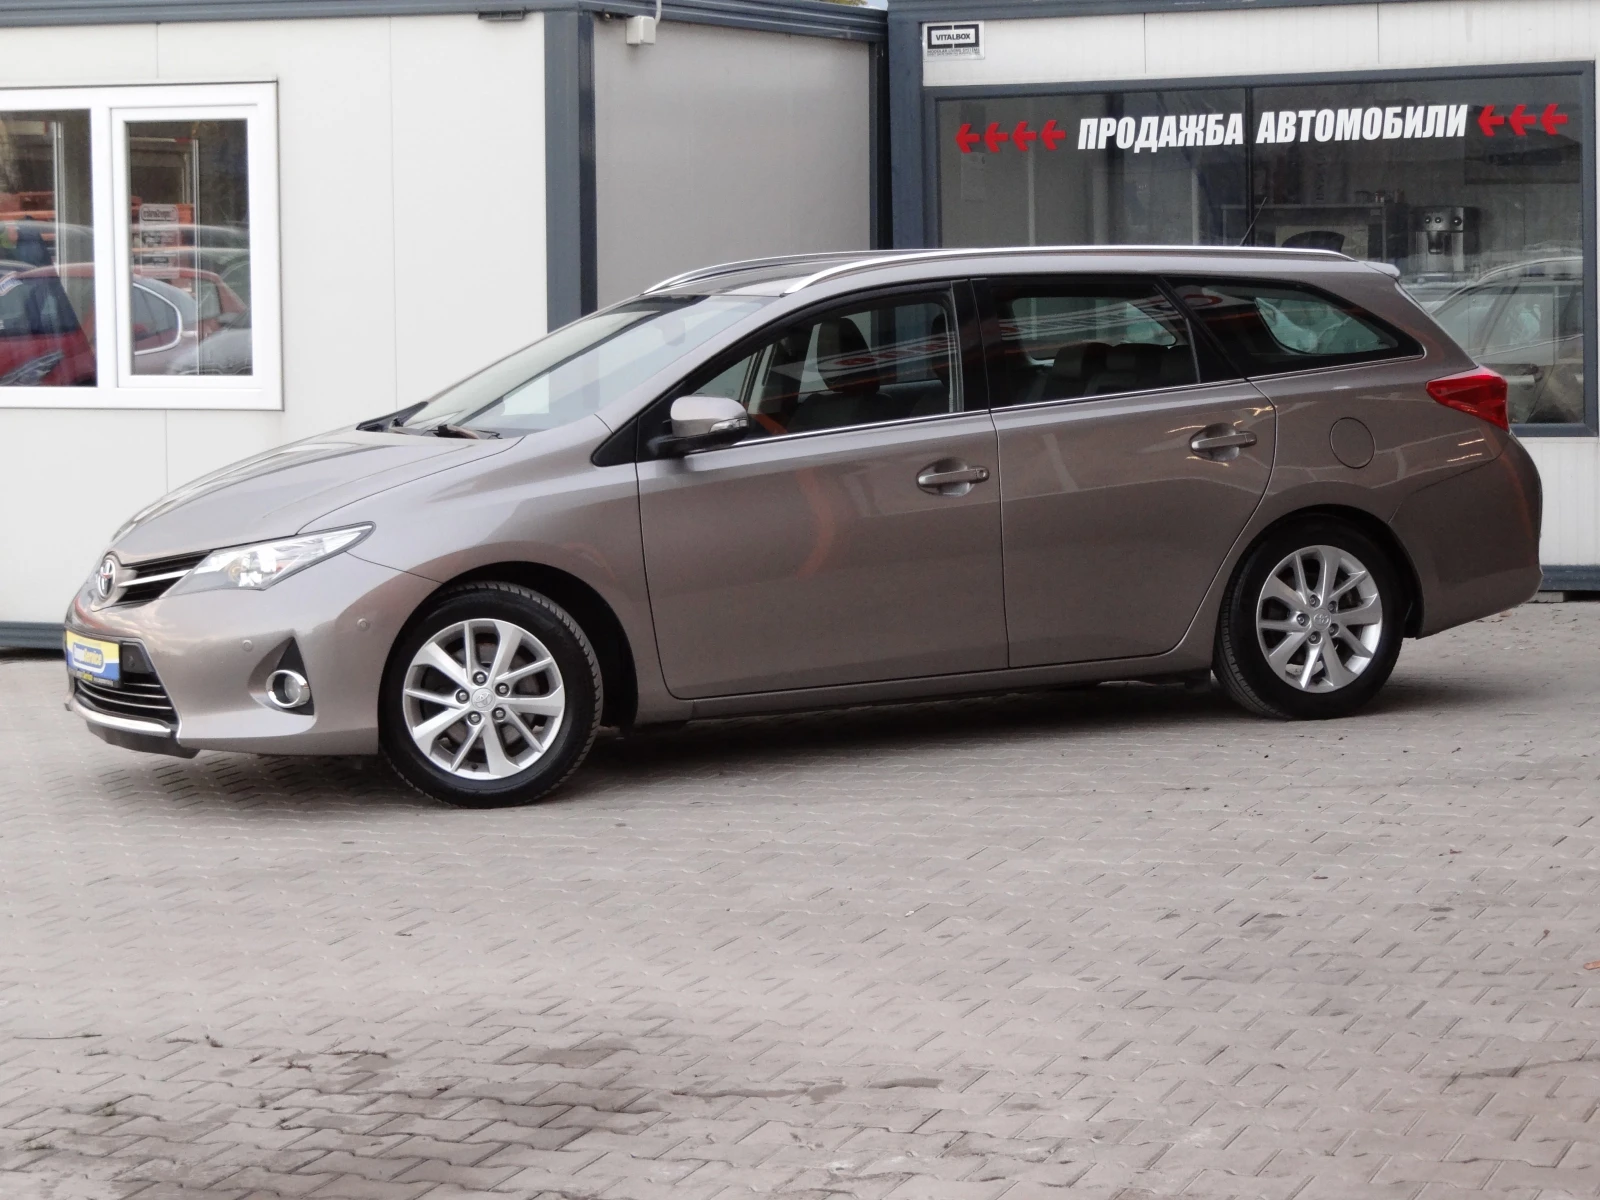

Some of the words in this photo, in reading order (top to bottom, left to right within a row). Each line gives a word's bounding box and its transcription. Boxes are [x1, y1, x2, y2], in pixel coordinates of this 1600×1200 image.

[936, 33, 971, 41] VITALBOX
[1077, 113, 1244, 154] ПРОДАЖБА
[1255, 104, 1468, 144] АВТОМОБИЛИ
